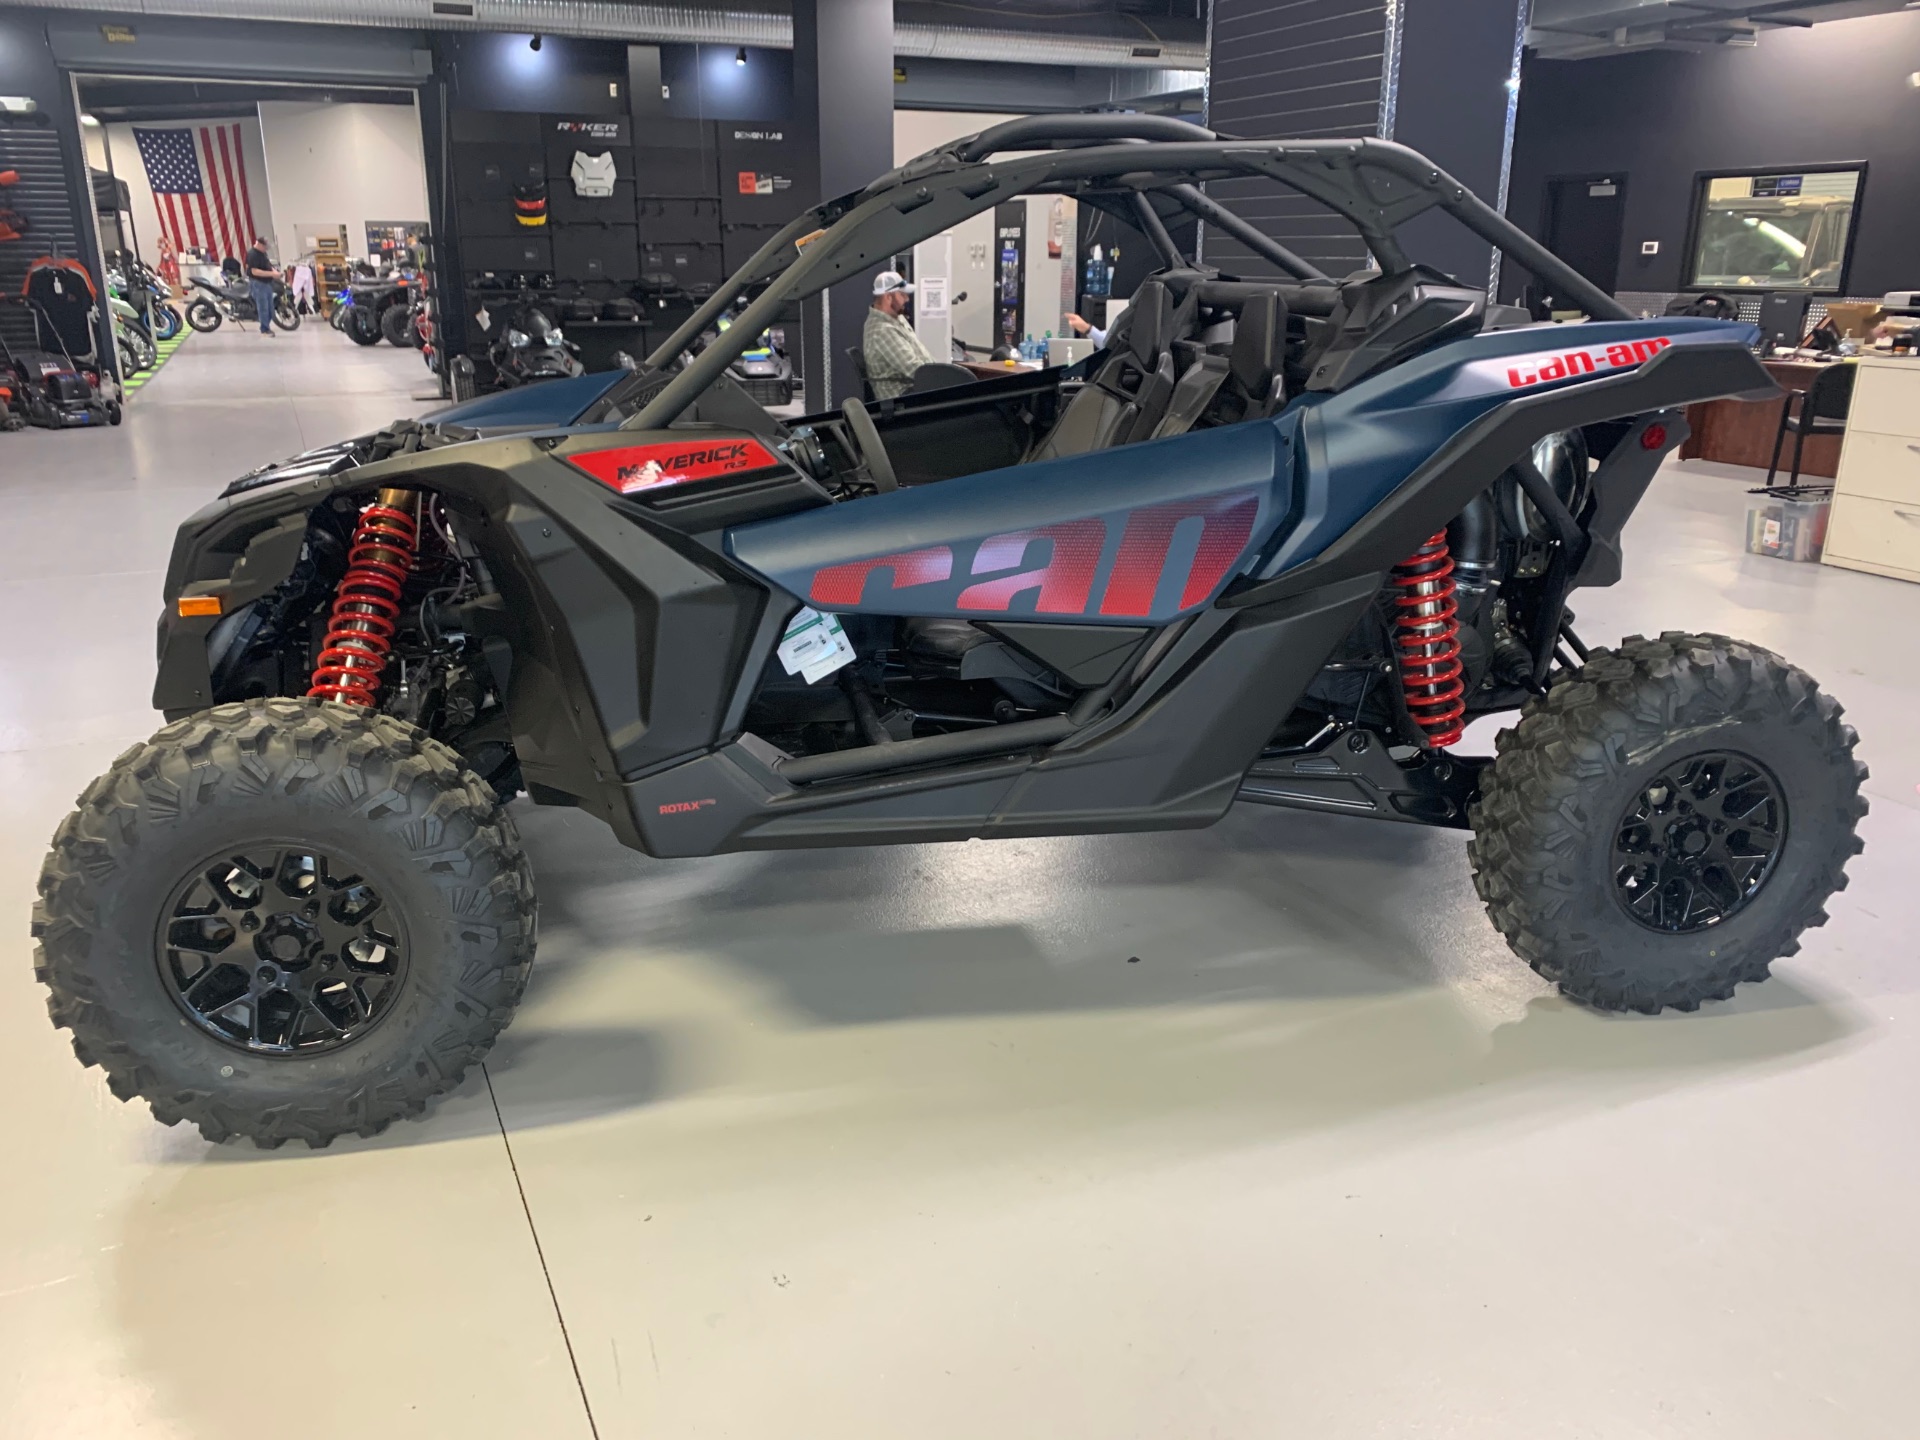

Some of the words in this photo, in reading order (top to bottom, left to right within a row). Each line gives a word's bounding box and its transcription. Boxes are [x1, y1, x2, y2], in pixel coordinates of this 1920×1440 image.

[557, 122, 619, 132] RYKER
[765, 131, 783, 140] LAB
[1507, 336, 1671, 388] can-am
[617, 443, 749, 480] MVERICK
[659, 801, 700, 815] ROTAX
